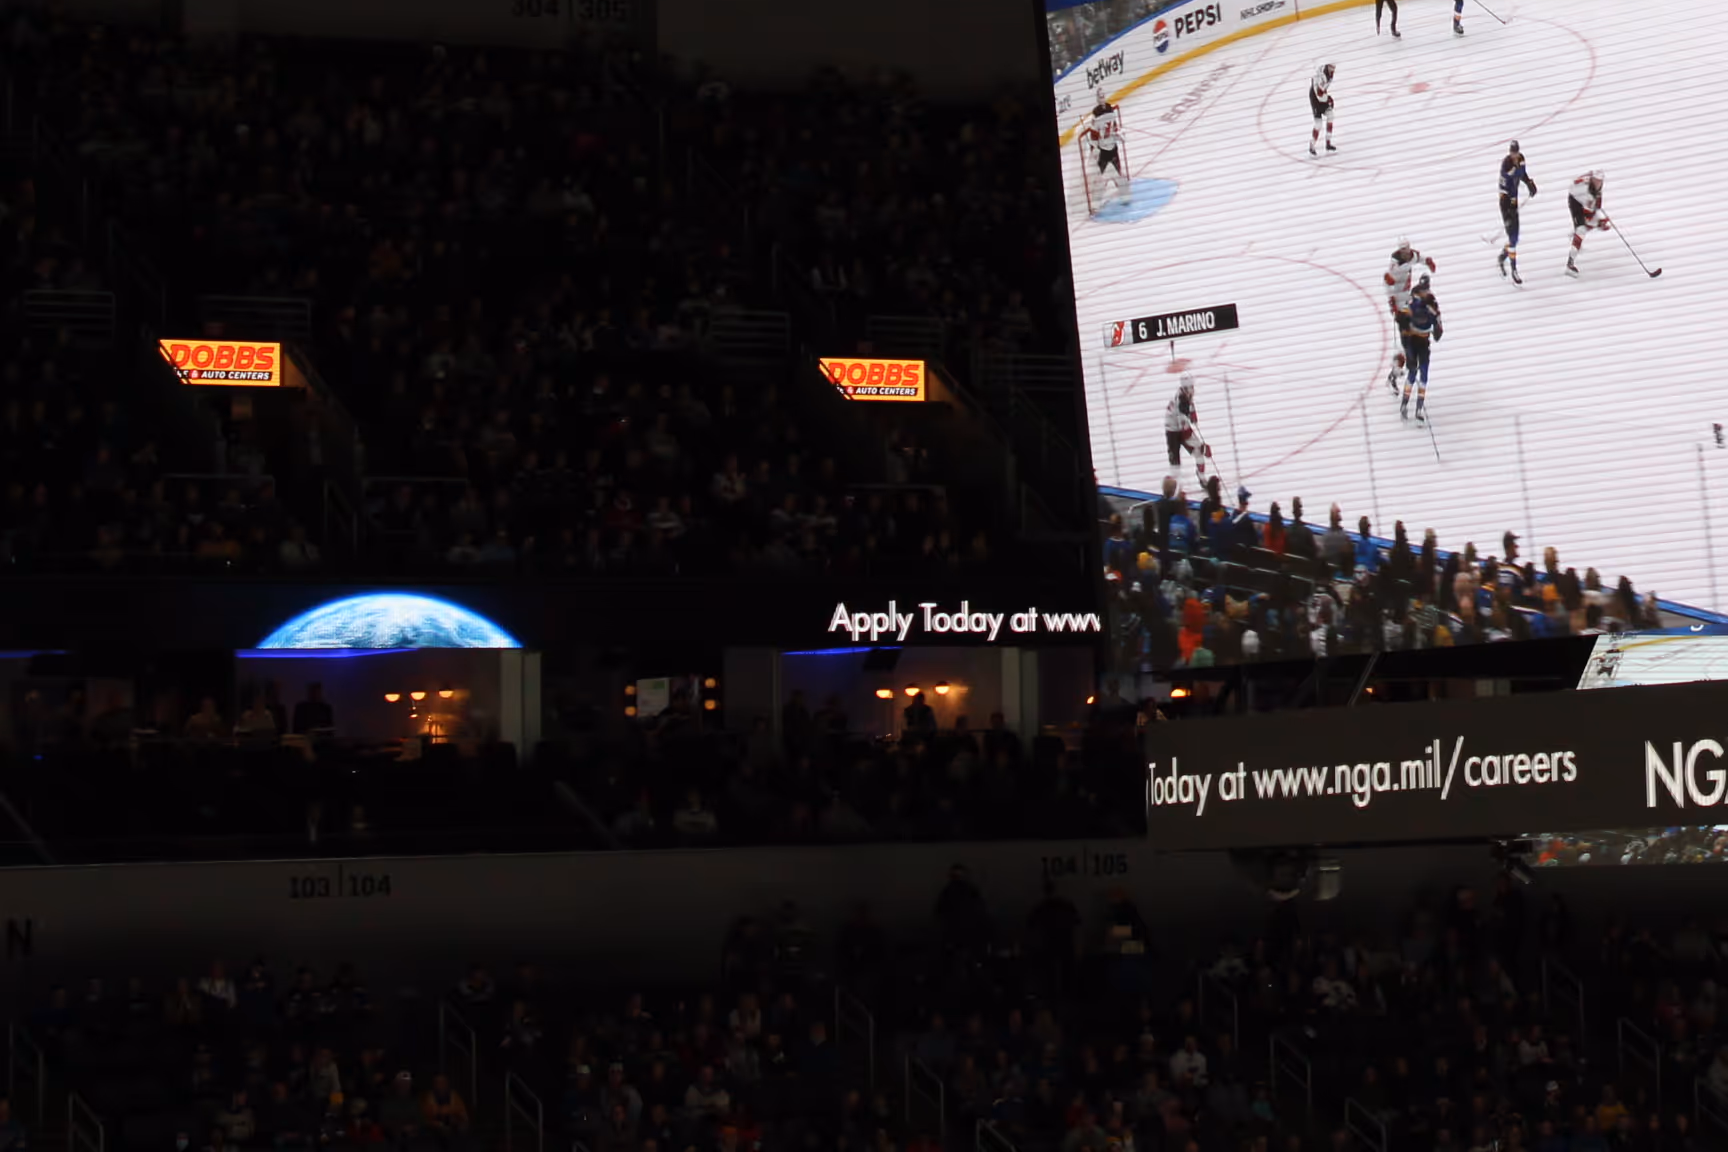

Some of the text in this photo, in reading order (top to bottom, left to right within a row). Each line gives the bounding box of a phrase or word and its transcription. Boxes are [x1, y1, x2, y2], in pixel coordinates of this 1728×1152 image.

[1174, 2, 1222, 39] PEPSI
[1087, 51, 1125, 89] betway
[1138, 311, 1215, 339] 6 J. MARINO
[171, 344, 275, 369] DOBBS
[201, 371, 270, 380] AUTO CENTERS
[828, 362, 920, 386] DOBBS
[856, 387, 916, 395] AUTO CENTERS
[827, 600, 914, 641] Apply
[918, 600, 1004, 641] Today
[1009, 607, 1038, 632] at
[1149, 735, 1576, 816] Today at www.nga.mil/careers
[289, 874, 392, 899] 103 104
